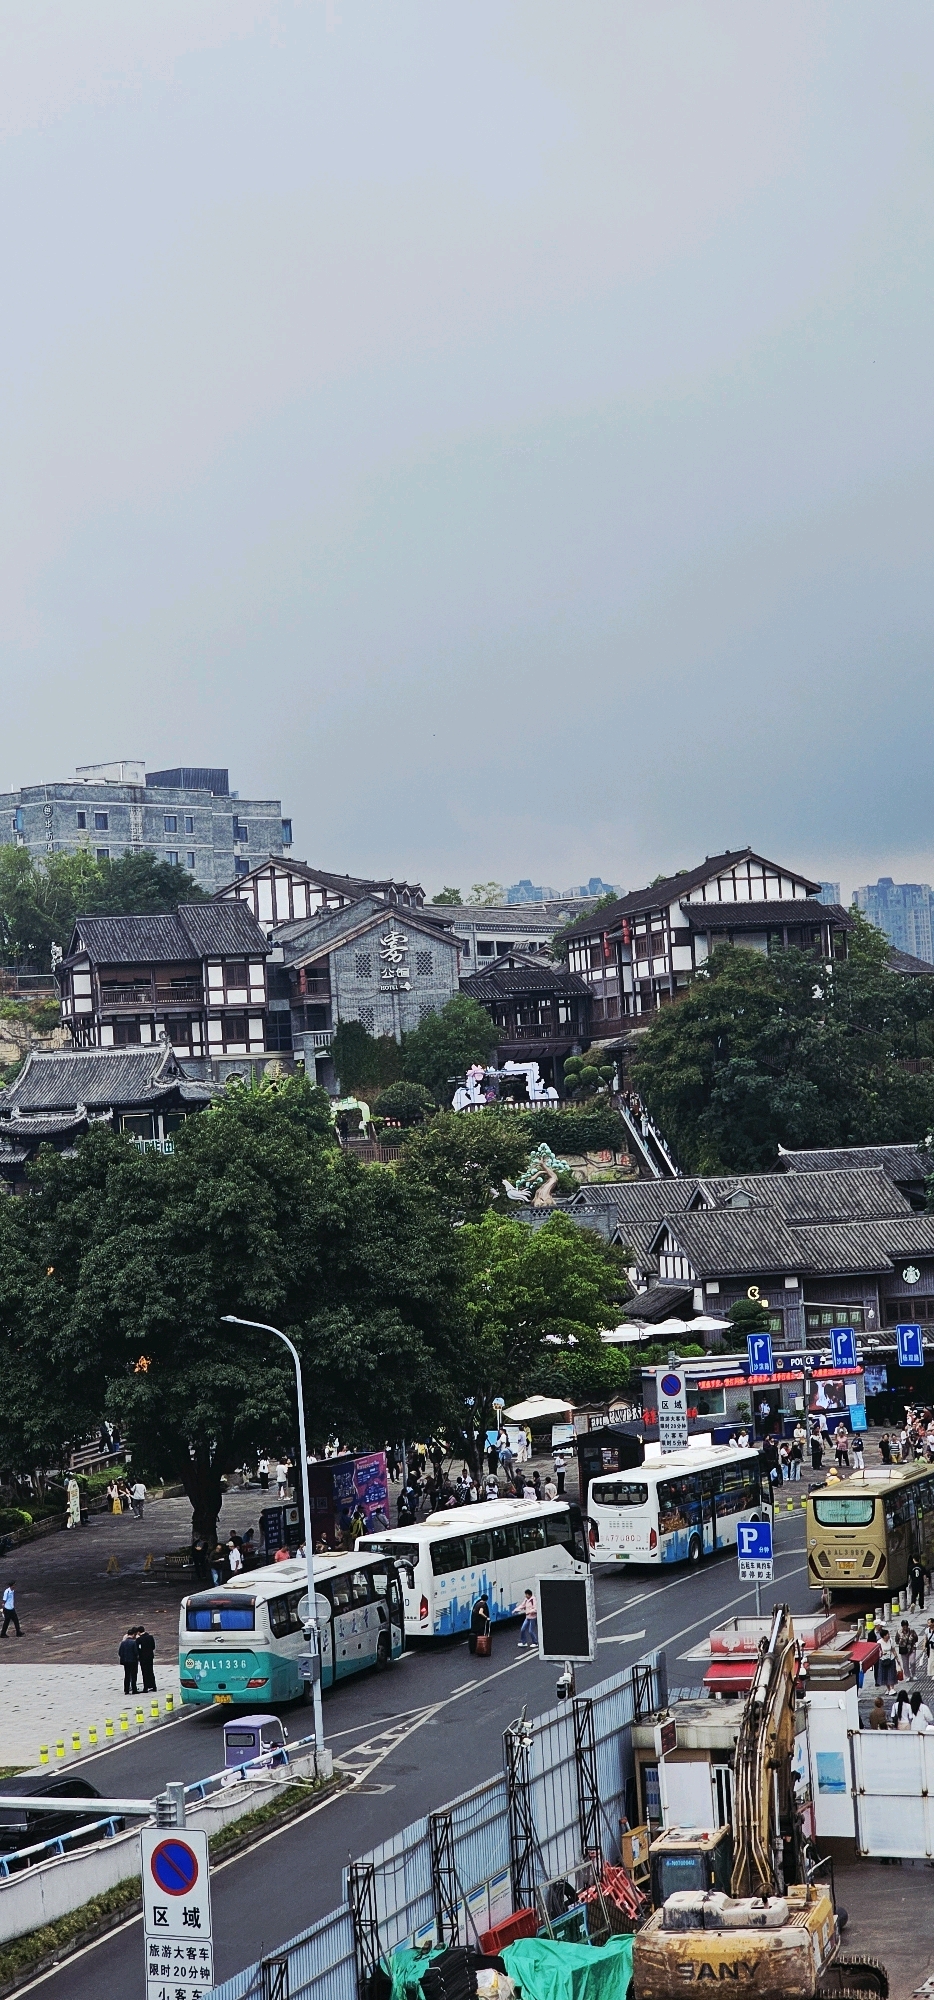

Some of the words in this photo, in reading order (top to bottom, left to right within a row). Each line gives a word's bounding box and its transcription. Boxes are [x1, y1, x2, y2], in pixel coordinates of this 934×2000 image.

[790, 1356, 814, 1366] POLCE
[662, 1401, 682, 1409] 区域
[740, 1528, 758, 1553] P
[153, 1906, 201, 1929] 区域
[149, 1944, 209, 1961] 旅游大客车
[149, 1963, 210, 1980] 限时20分钟
[676, 1962, 761, 1981] SANY
